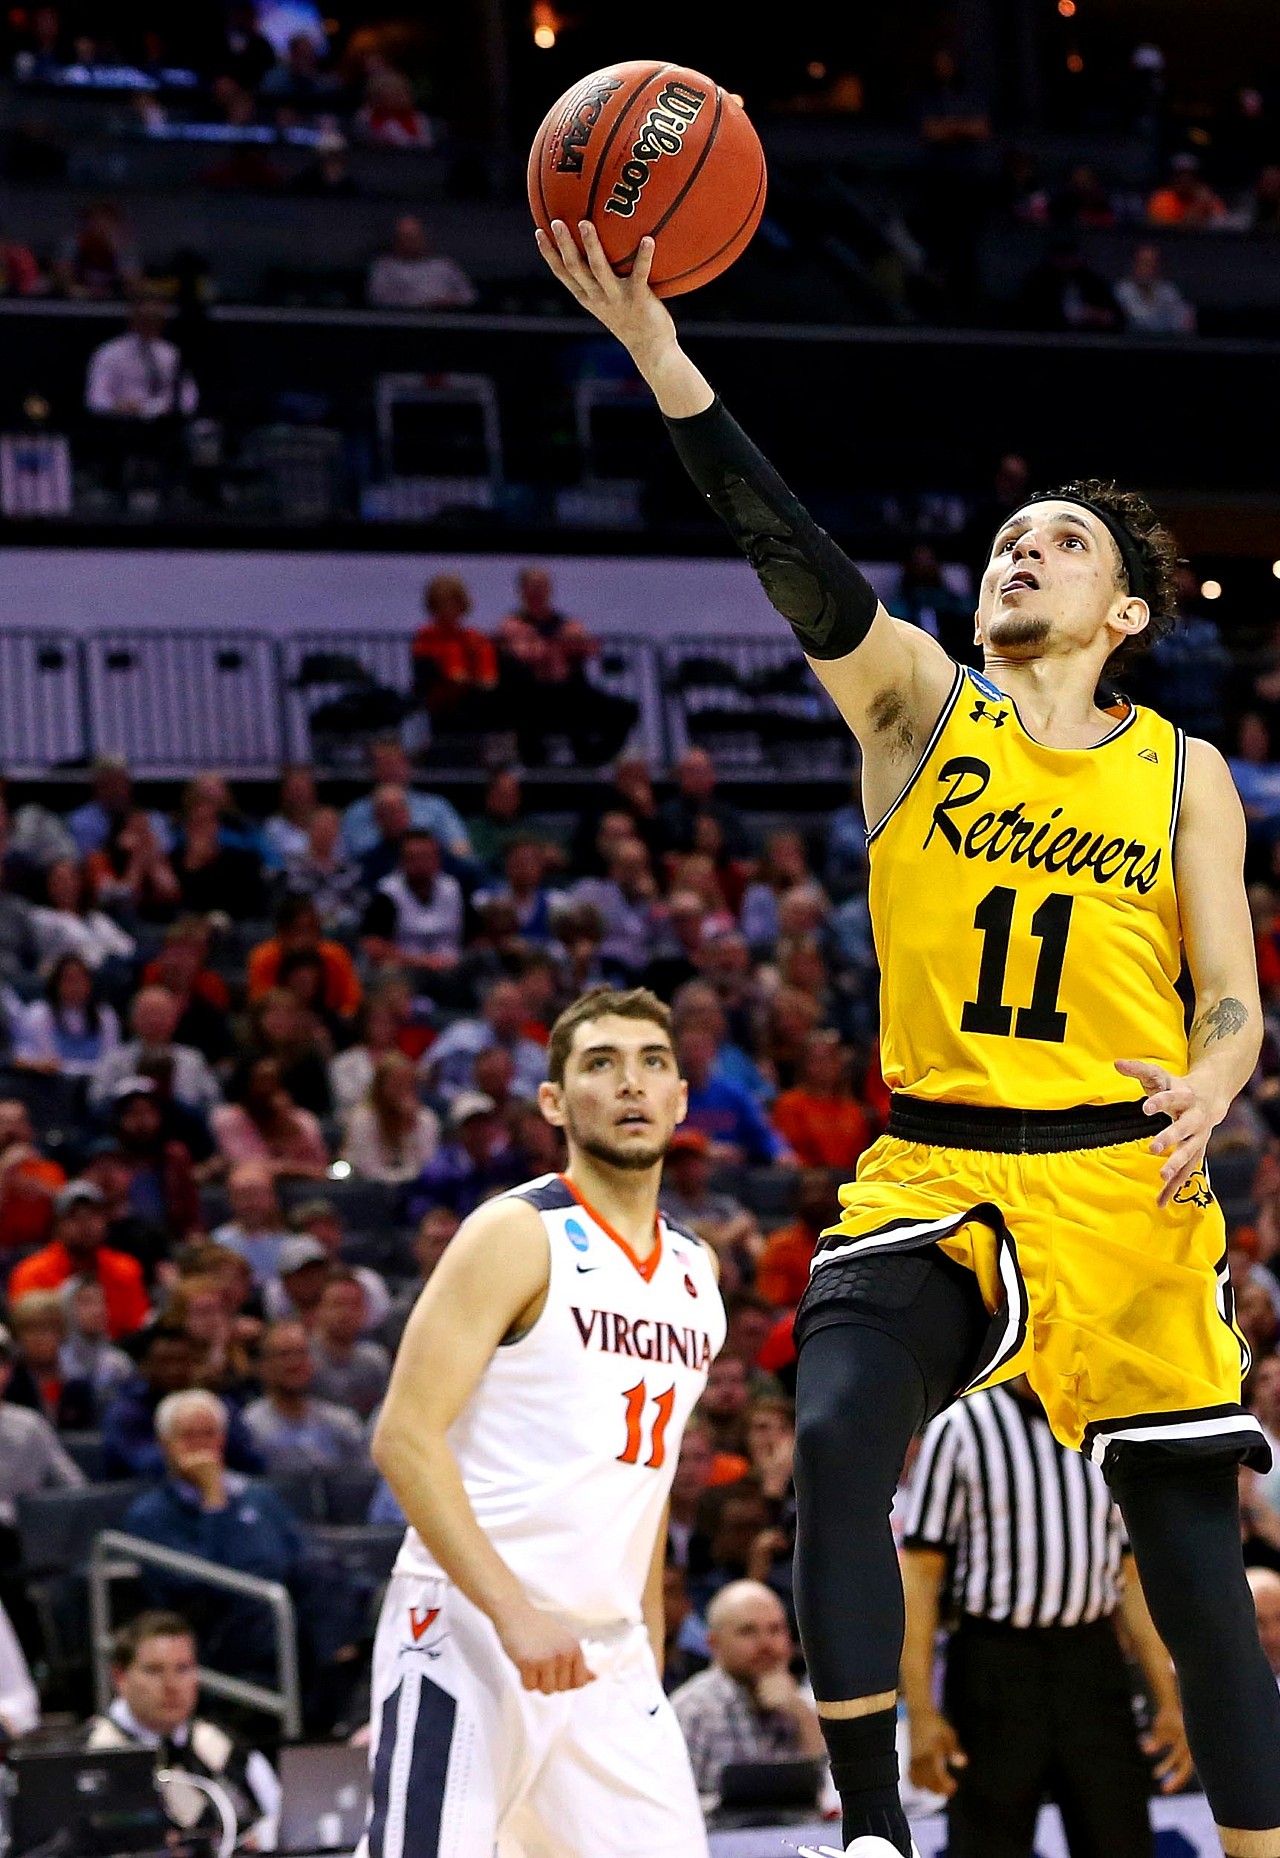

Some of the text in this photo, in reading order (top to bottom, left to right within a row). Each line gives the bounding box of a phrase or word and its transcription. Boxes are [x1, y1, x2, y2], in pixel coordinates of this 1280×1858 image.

[604, 80, 707, 218] Wilson
[923, 756, 1162, 894] Retrievers
[960, 885, 1075, 1043] 11
[569, 1306, 712, 1373] VIRGINIA
[615, 1376, 676, 1469] 11
